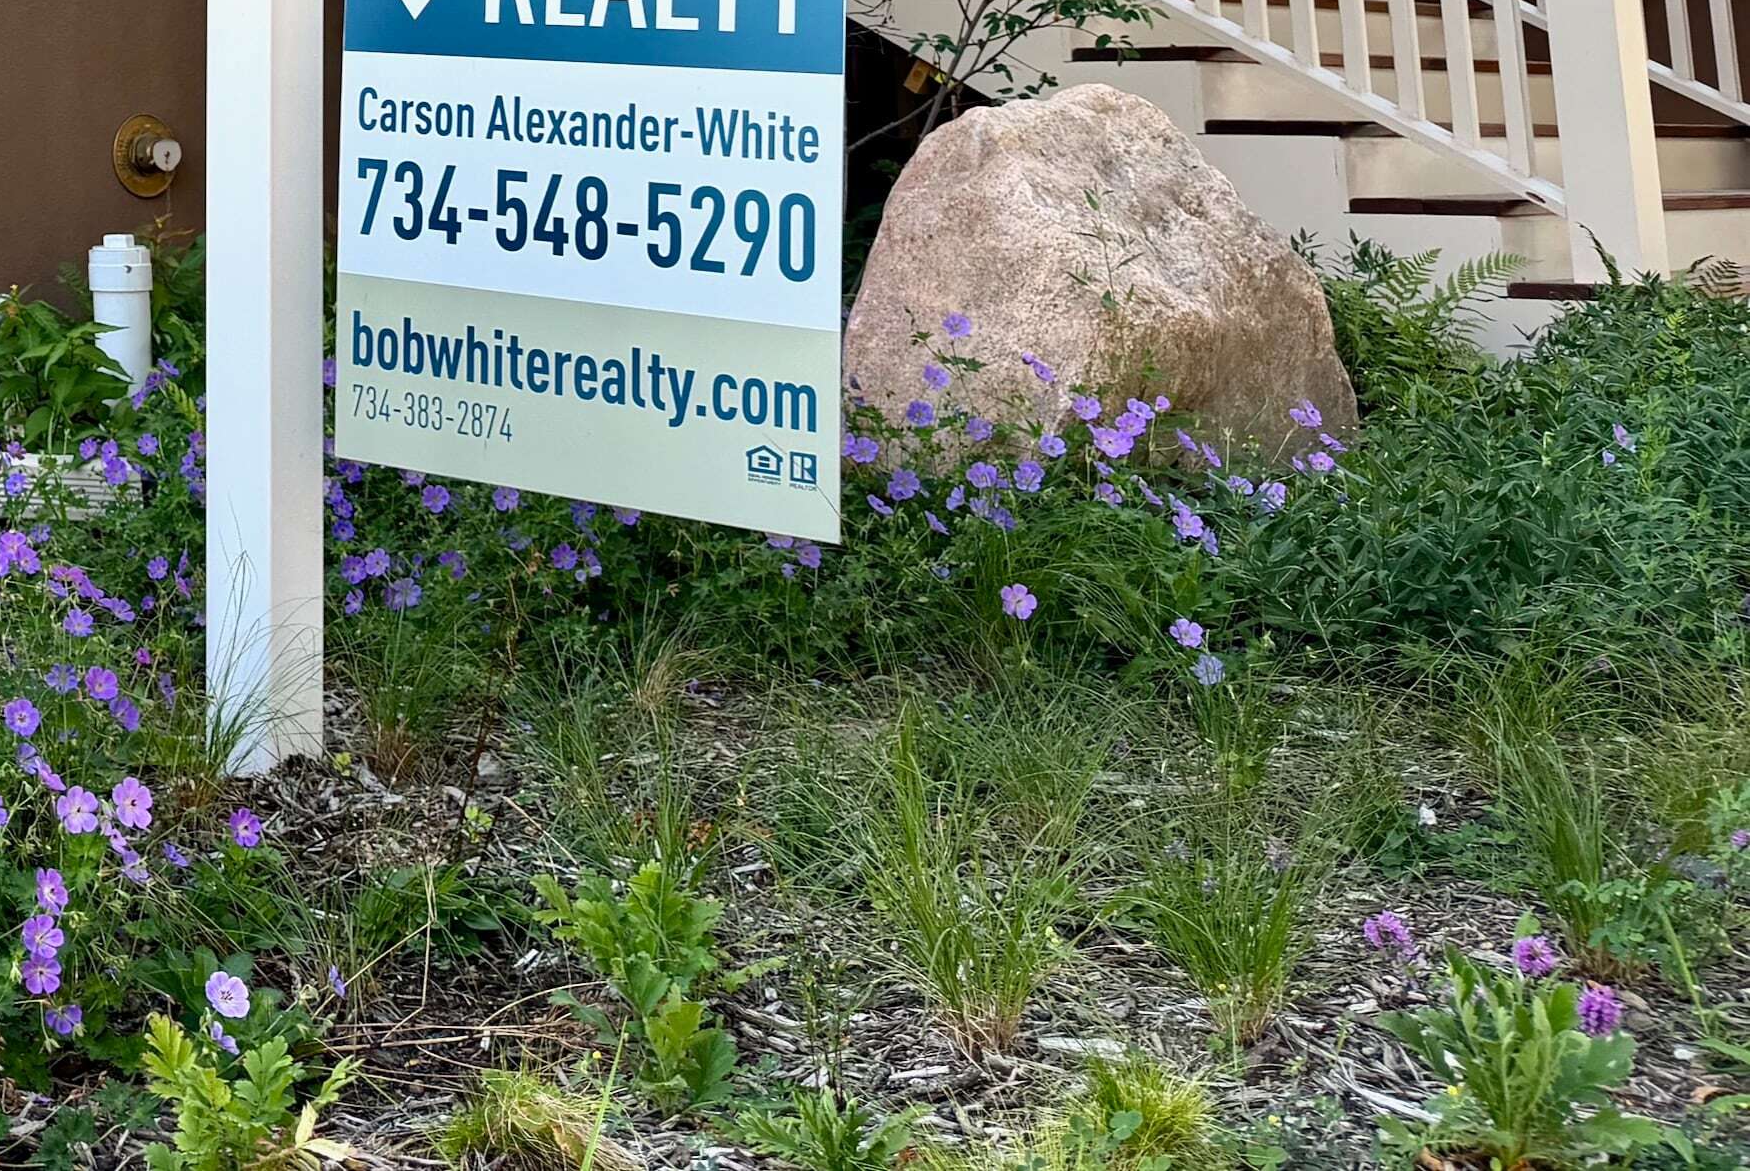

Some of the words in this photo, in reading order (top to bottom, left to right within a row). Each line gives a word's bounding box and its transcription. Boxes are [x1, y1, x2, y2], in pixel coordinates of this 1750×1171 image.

[358, 86, 475, 138] Carson
[486, 95, 819, 164] Alexander-White
[357, 157, 816, 283] 734-548-5290
[352, 310, 817, 433] bobwhiterealty.com
[352, 383, 513, 443] 734-383-2874
